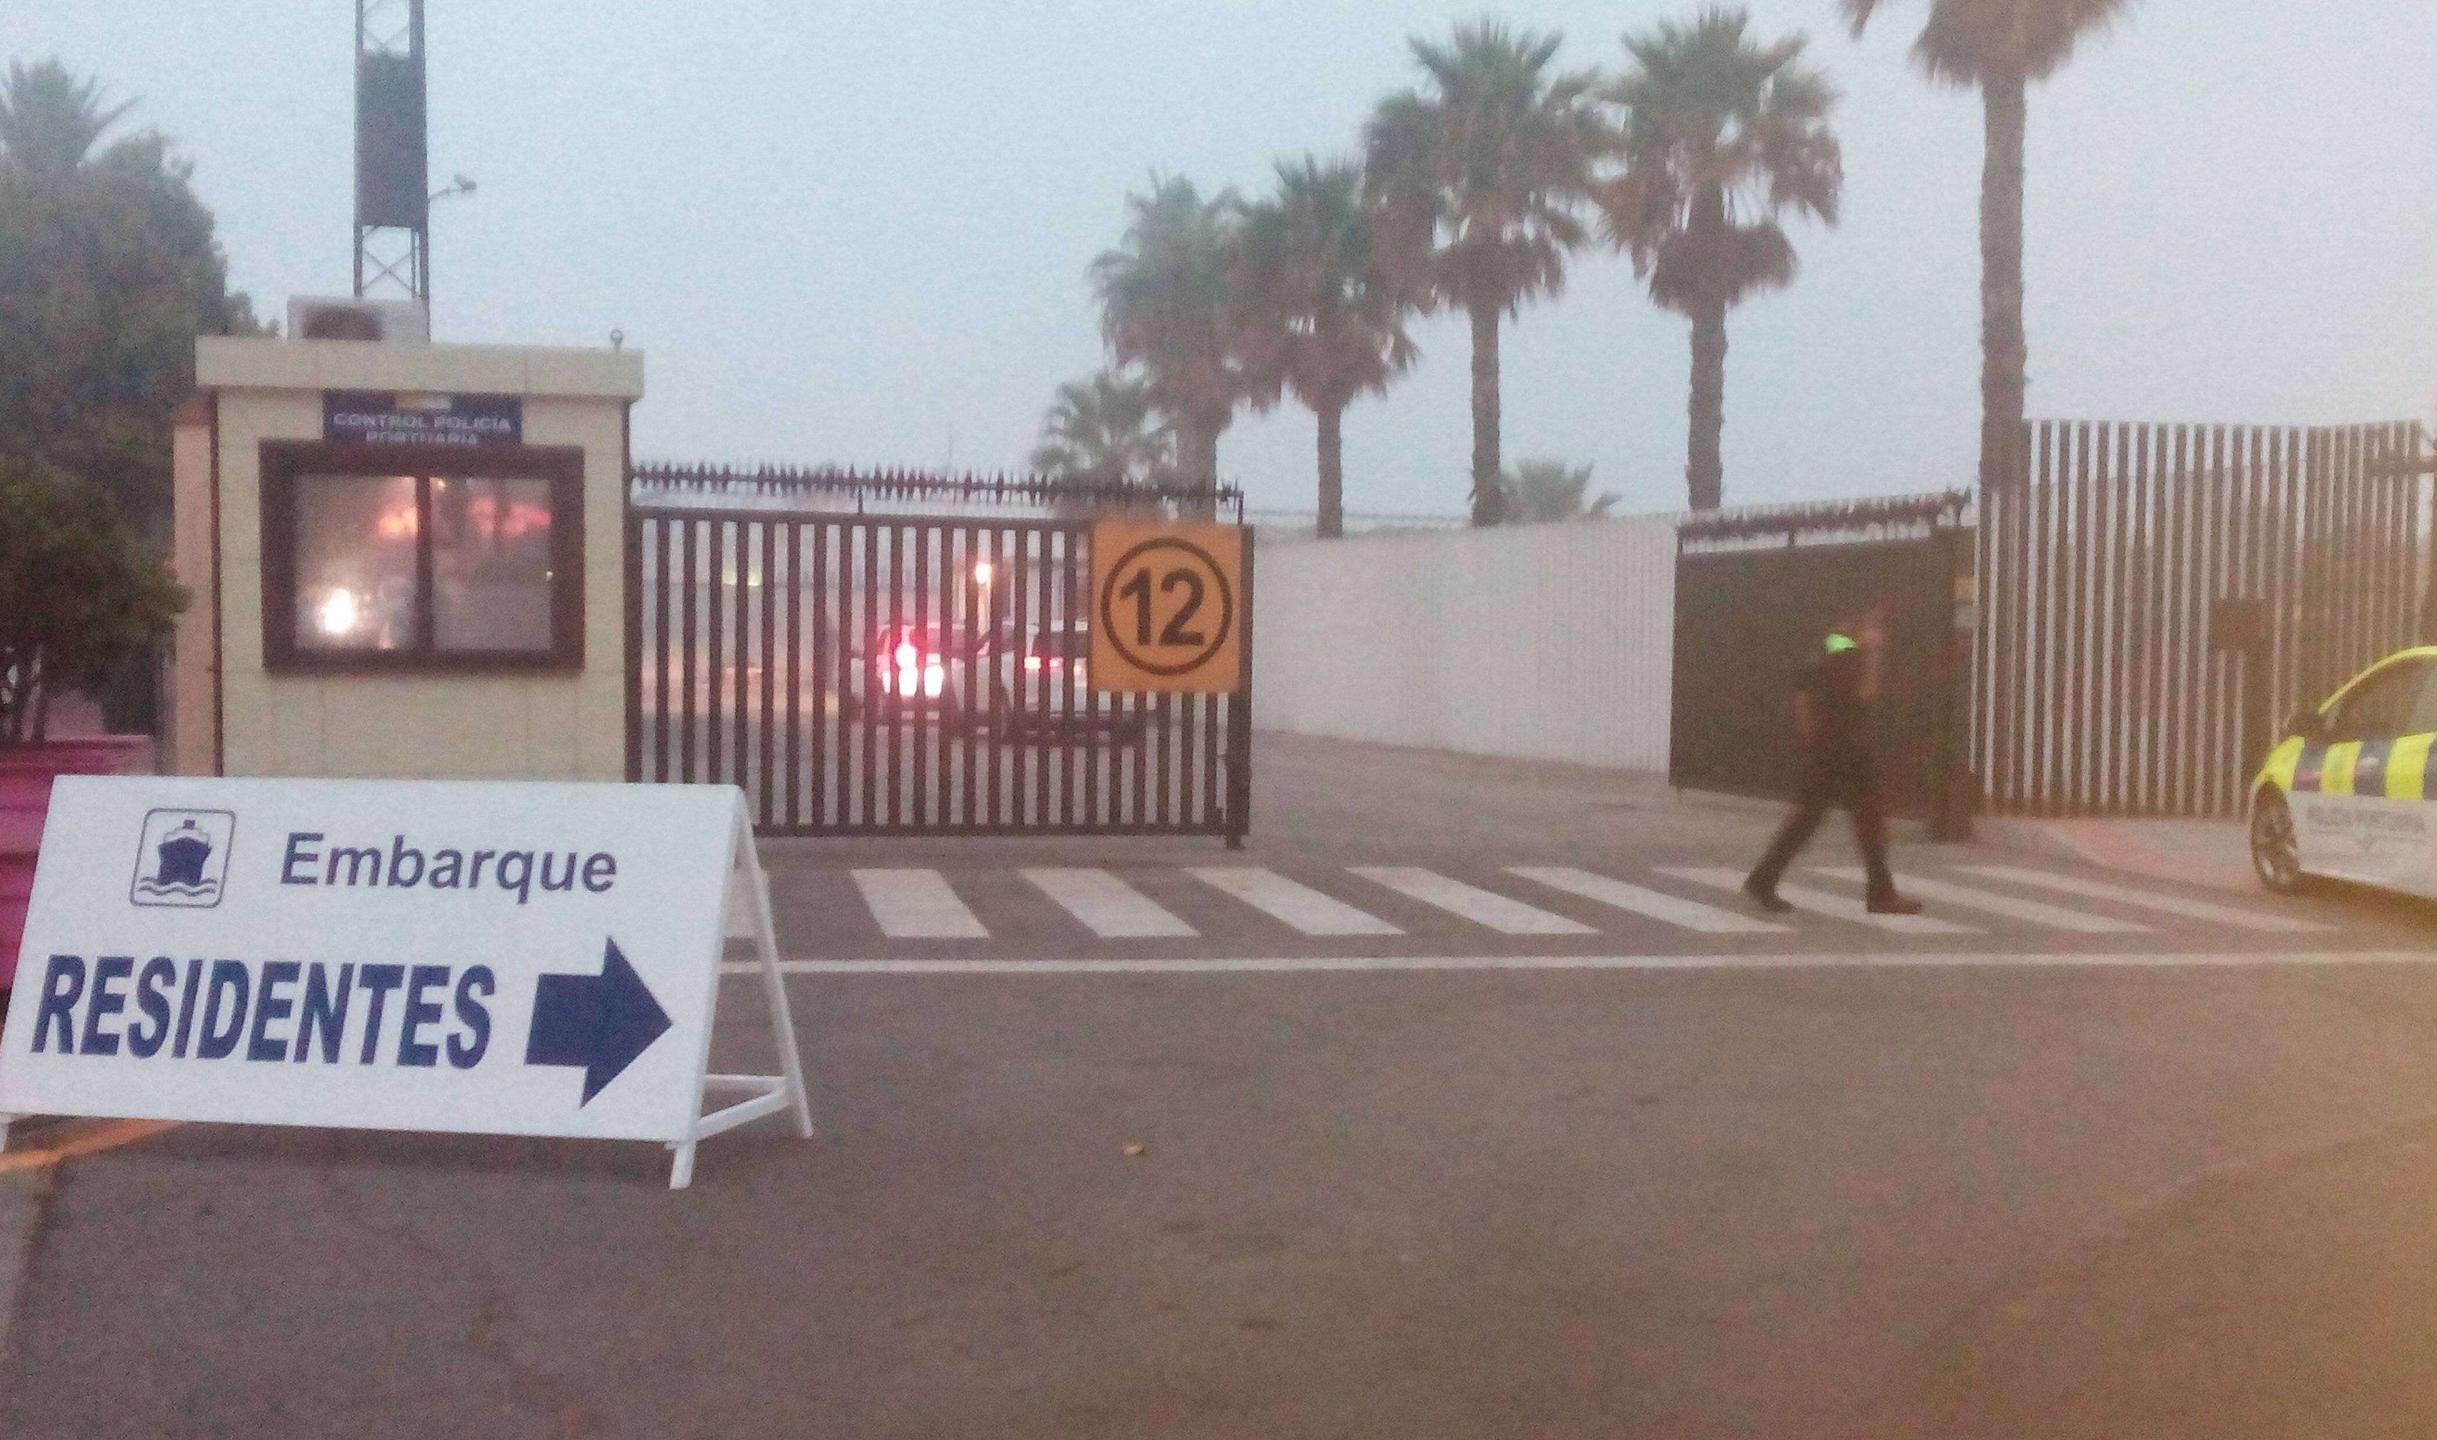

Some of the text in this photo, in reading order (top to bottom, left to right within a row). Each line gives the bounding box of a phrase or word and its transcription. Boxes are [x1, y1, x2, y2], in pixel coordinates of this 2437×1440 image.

[333, 412, 426, 429] CONTROL
[1118, 567, 1206, 646] 12
[280, 832, 618, 904] Embarque
[30, 954, 496, 1069] RESIDENTES
